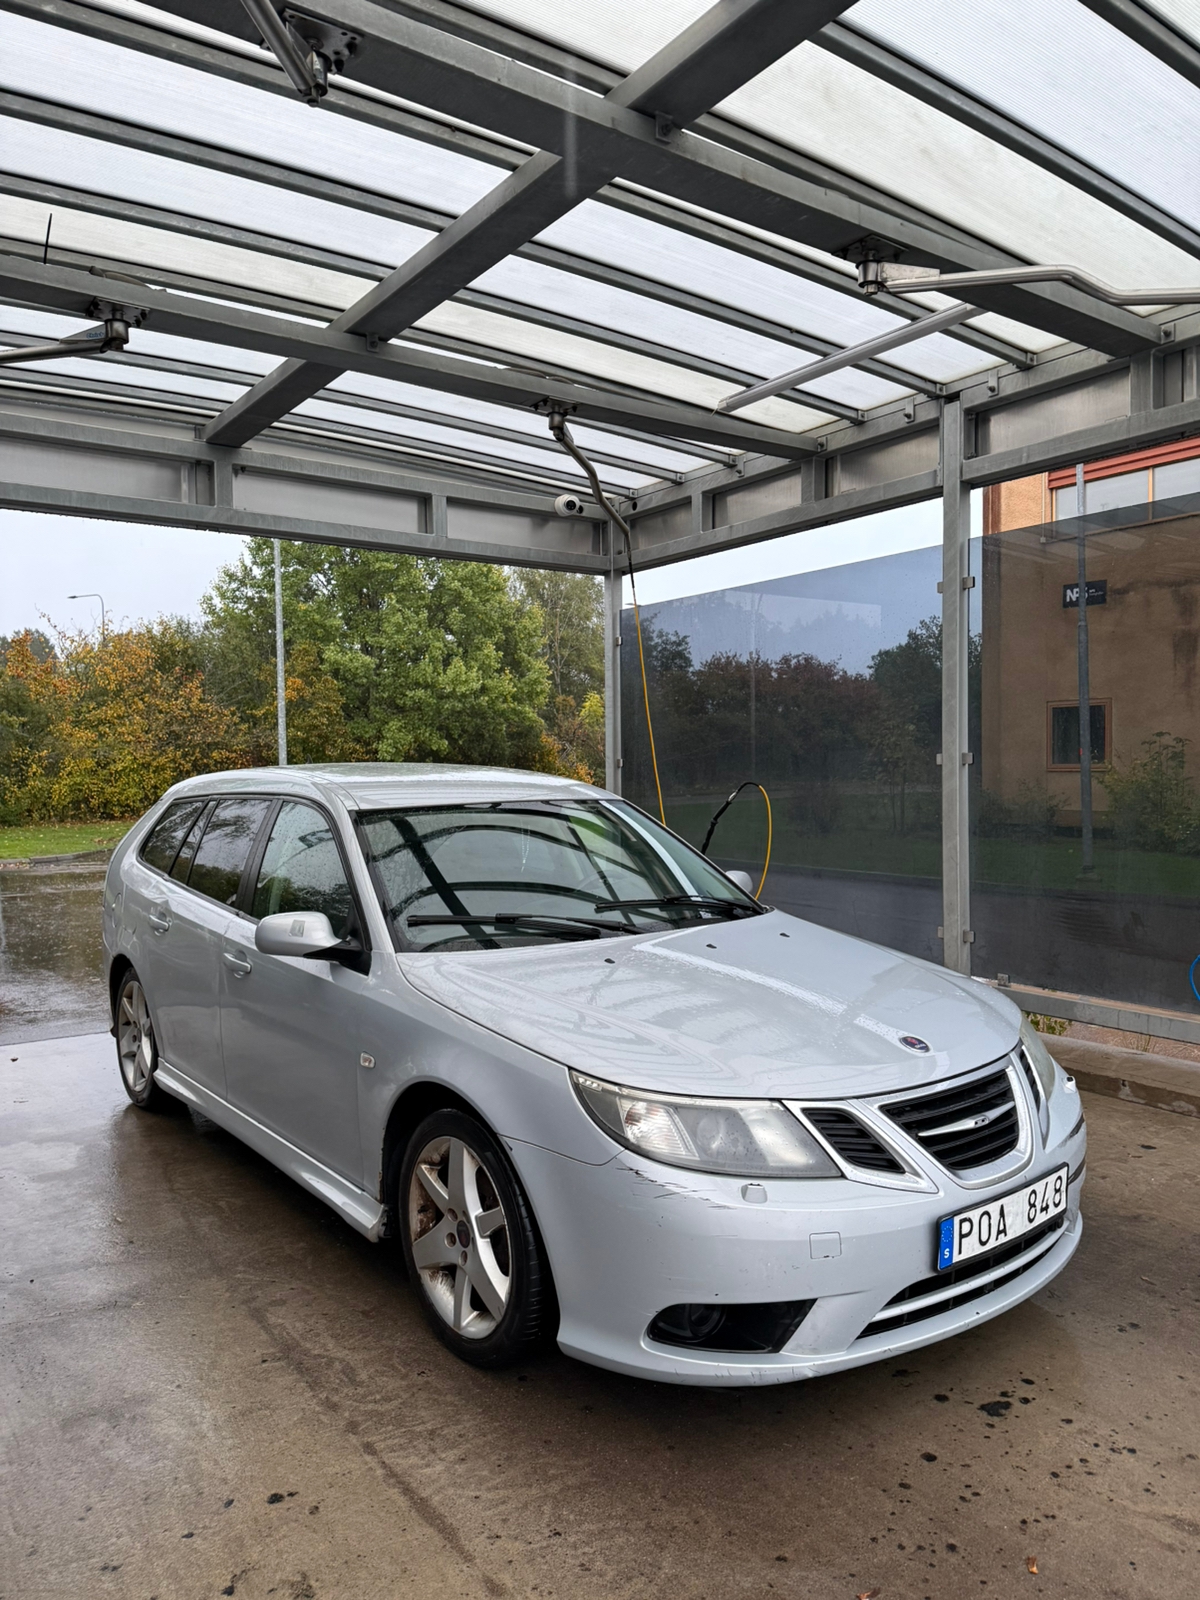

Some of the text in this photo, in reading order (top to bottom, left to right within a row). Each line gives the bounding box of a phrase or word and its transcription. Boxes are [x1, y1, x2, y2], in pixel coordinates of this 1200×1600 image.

[958, 1175, 1063, 1255] POA 848
[943, 1248, 950, 1259] S
